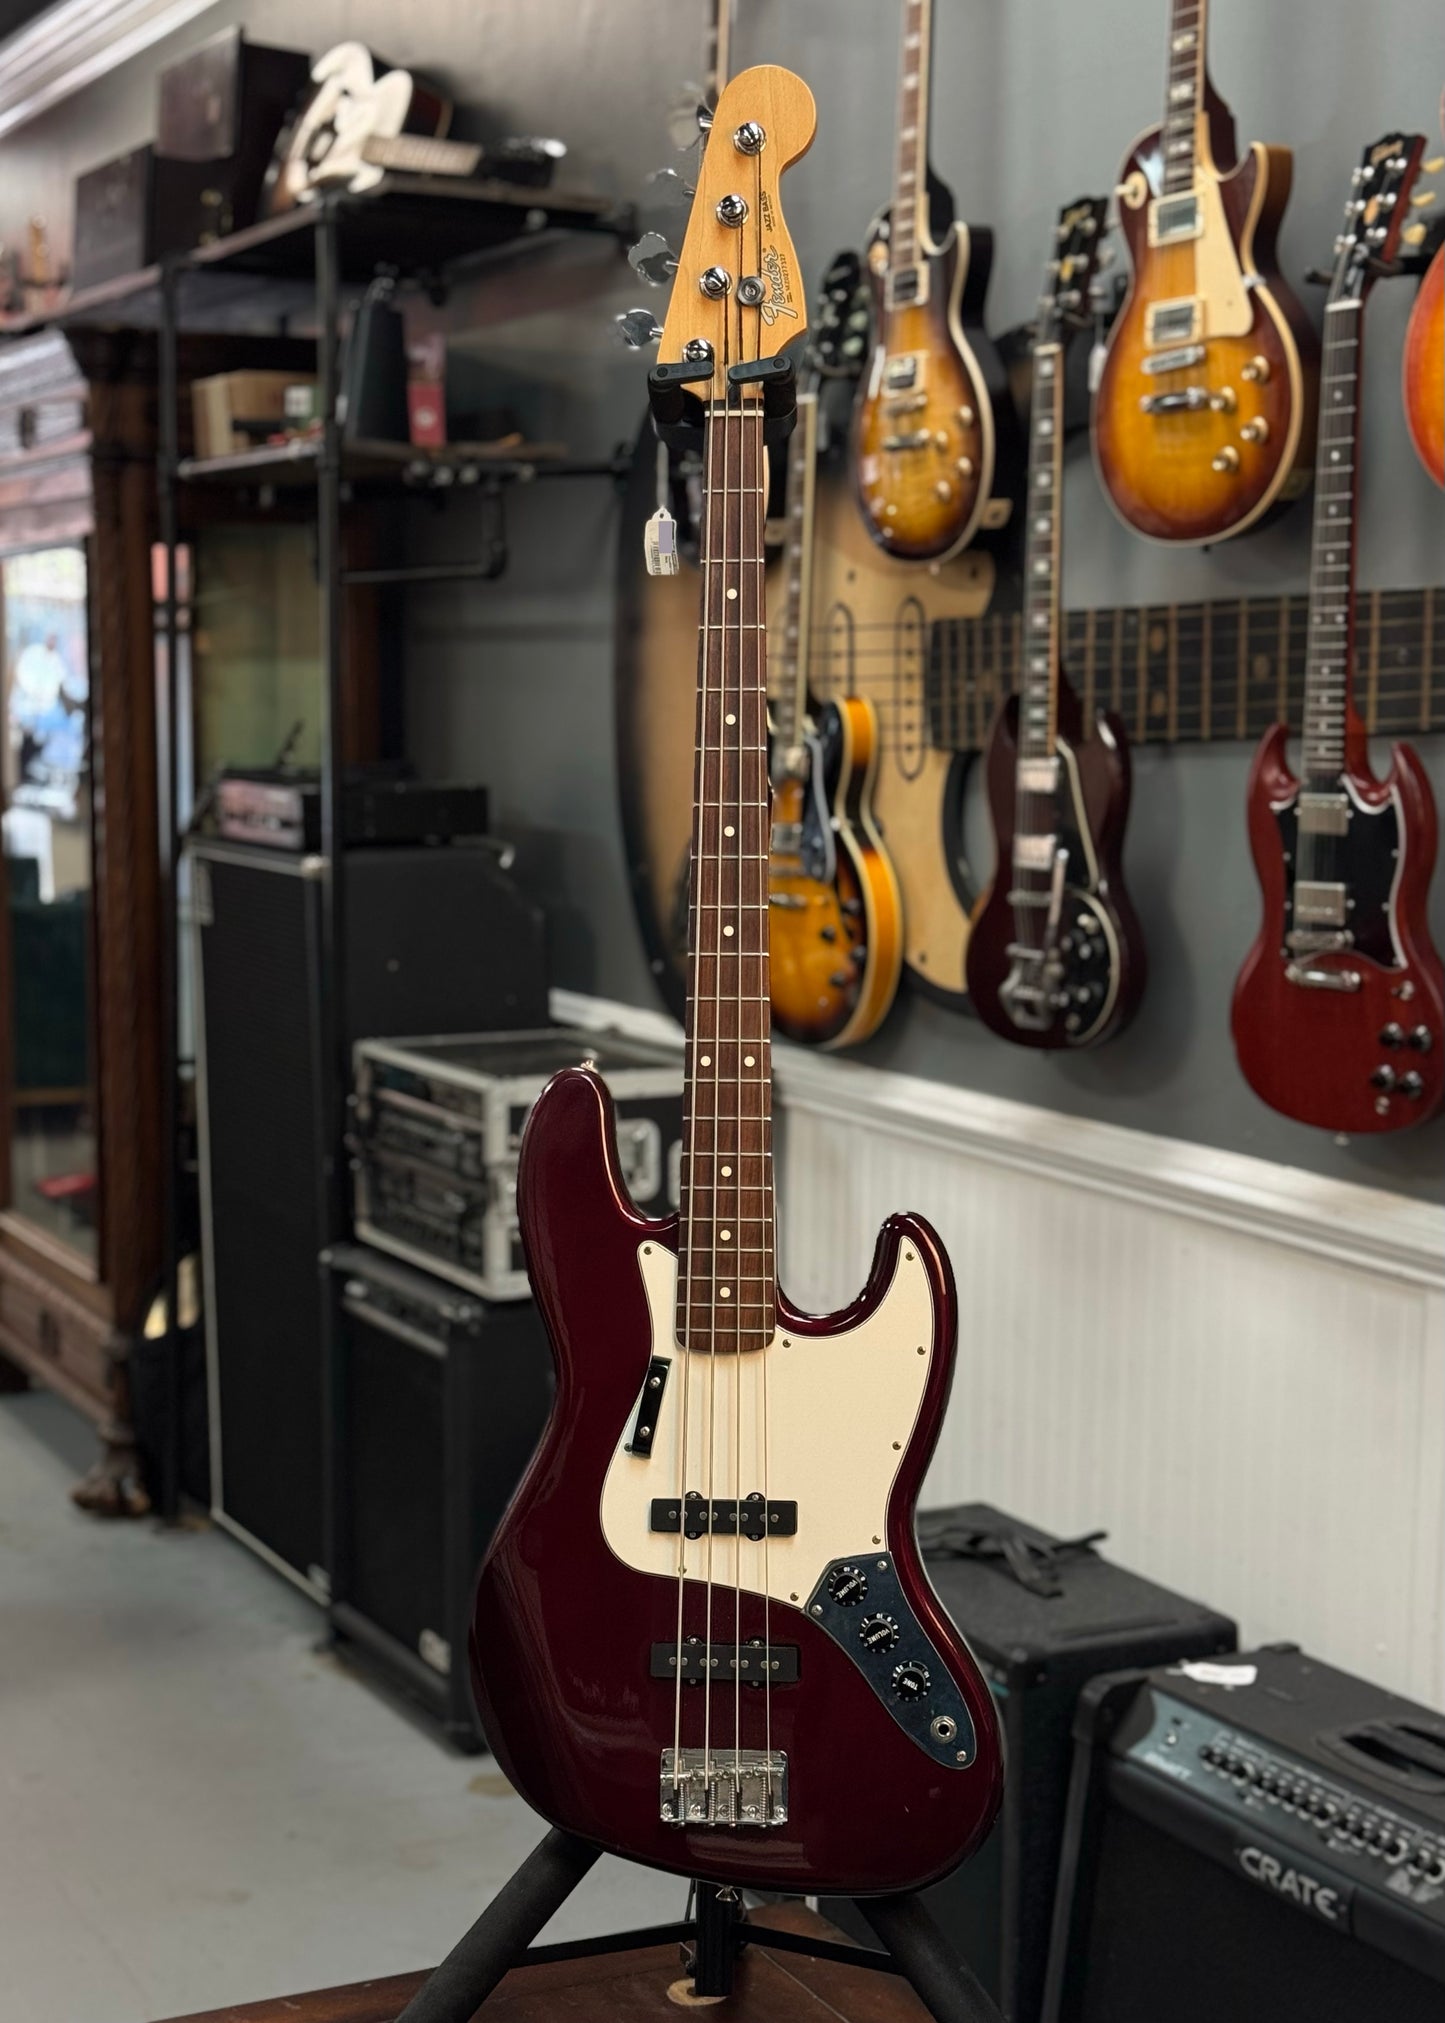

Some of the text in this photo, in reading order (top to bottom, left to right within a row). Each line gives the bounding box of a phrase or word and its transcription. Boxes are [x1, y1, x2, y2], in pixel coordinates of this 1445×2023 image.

[760, 190, 770, 212] BASS
[765, 213, 773, 232] JAZZ
[761, 245, 798, 326] Fender
[835, 1579, 858, 1599] VOLUME
[866, 1628, 890, 1645] VOLUME
[902, 1677, 918, 1691] TONE
[1240, 1846, 1338, 1920] CRATE
